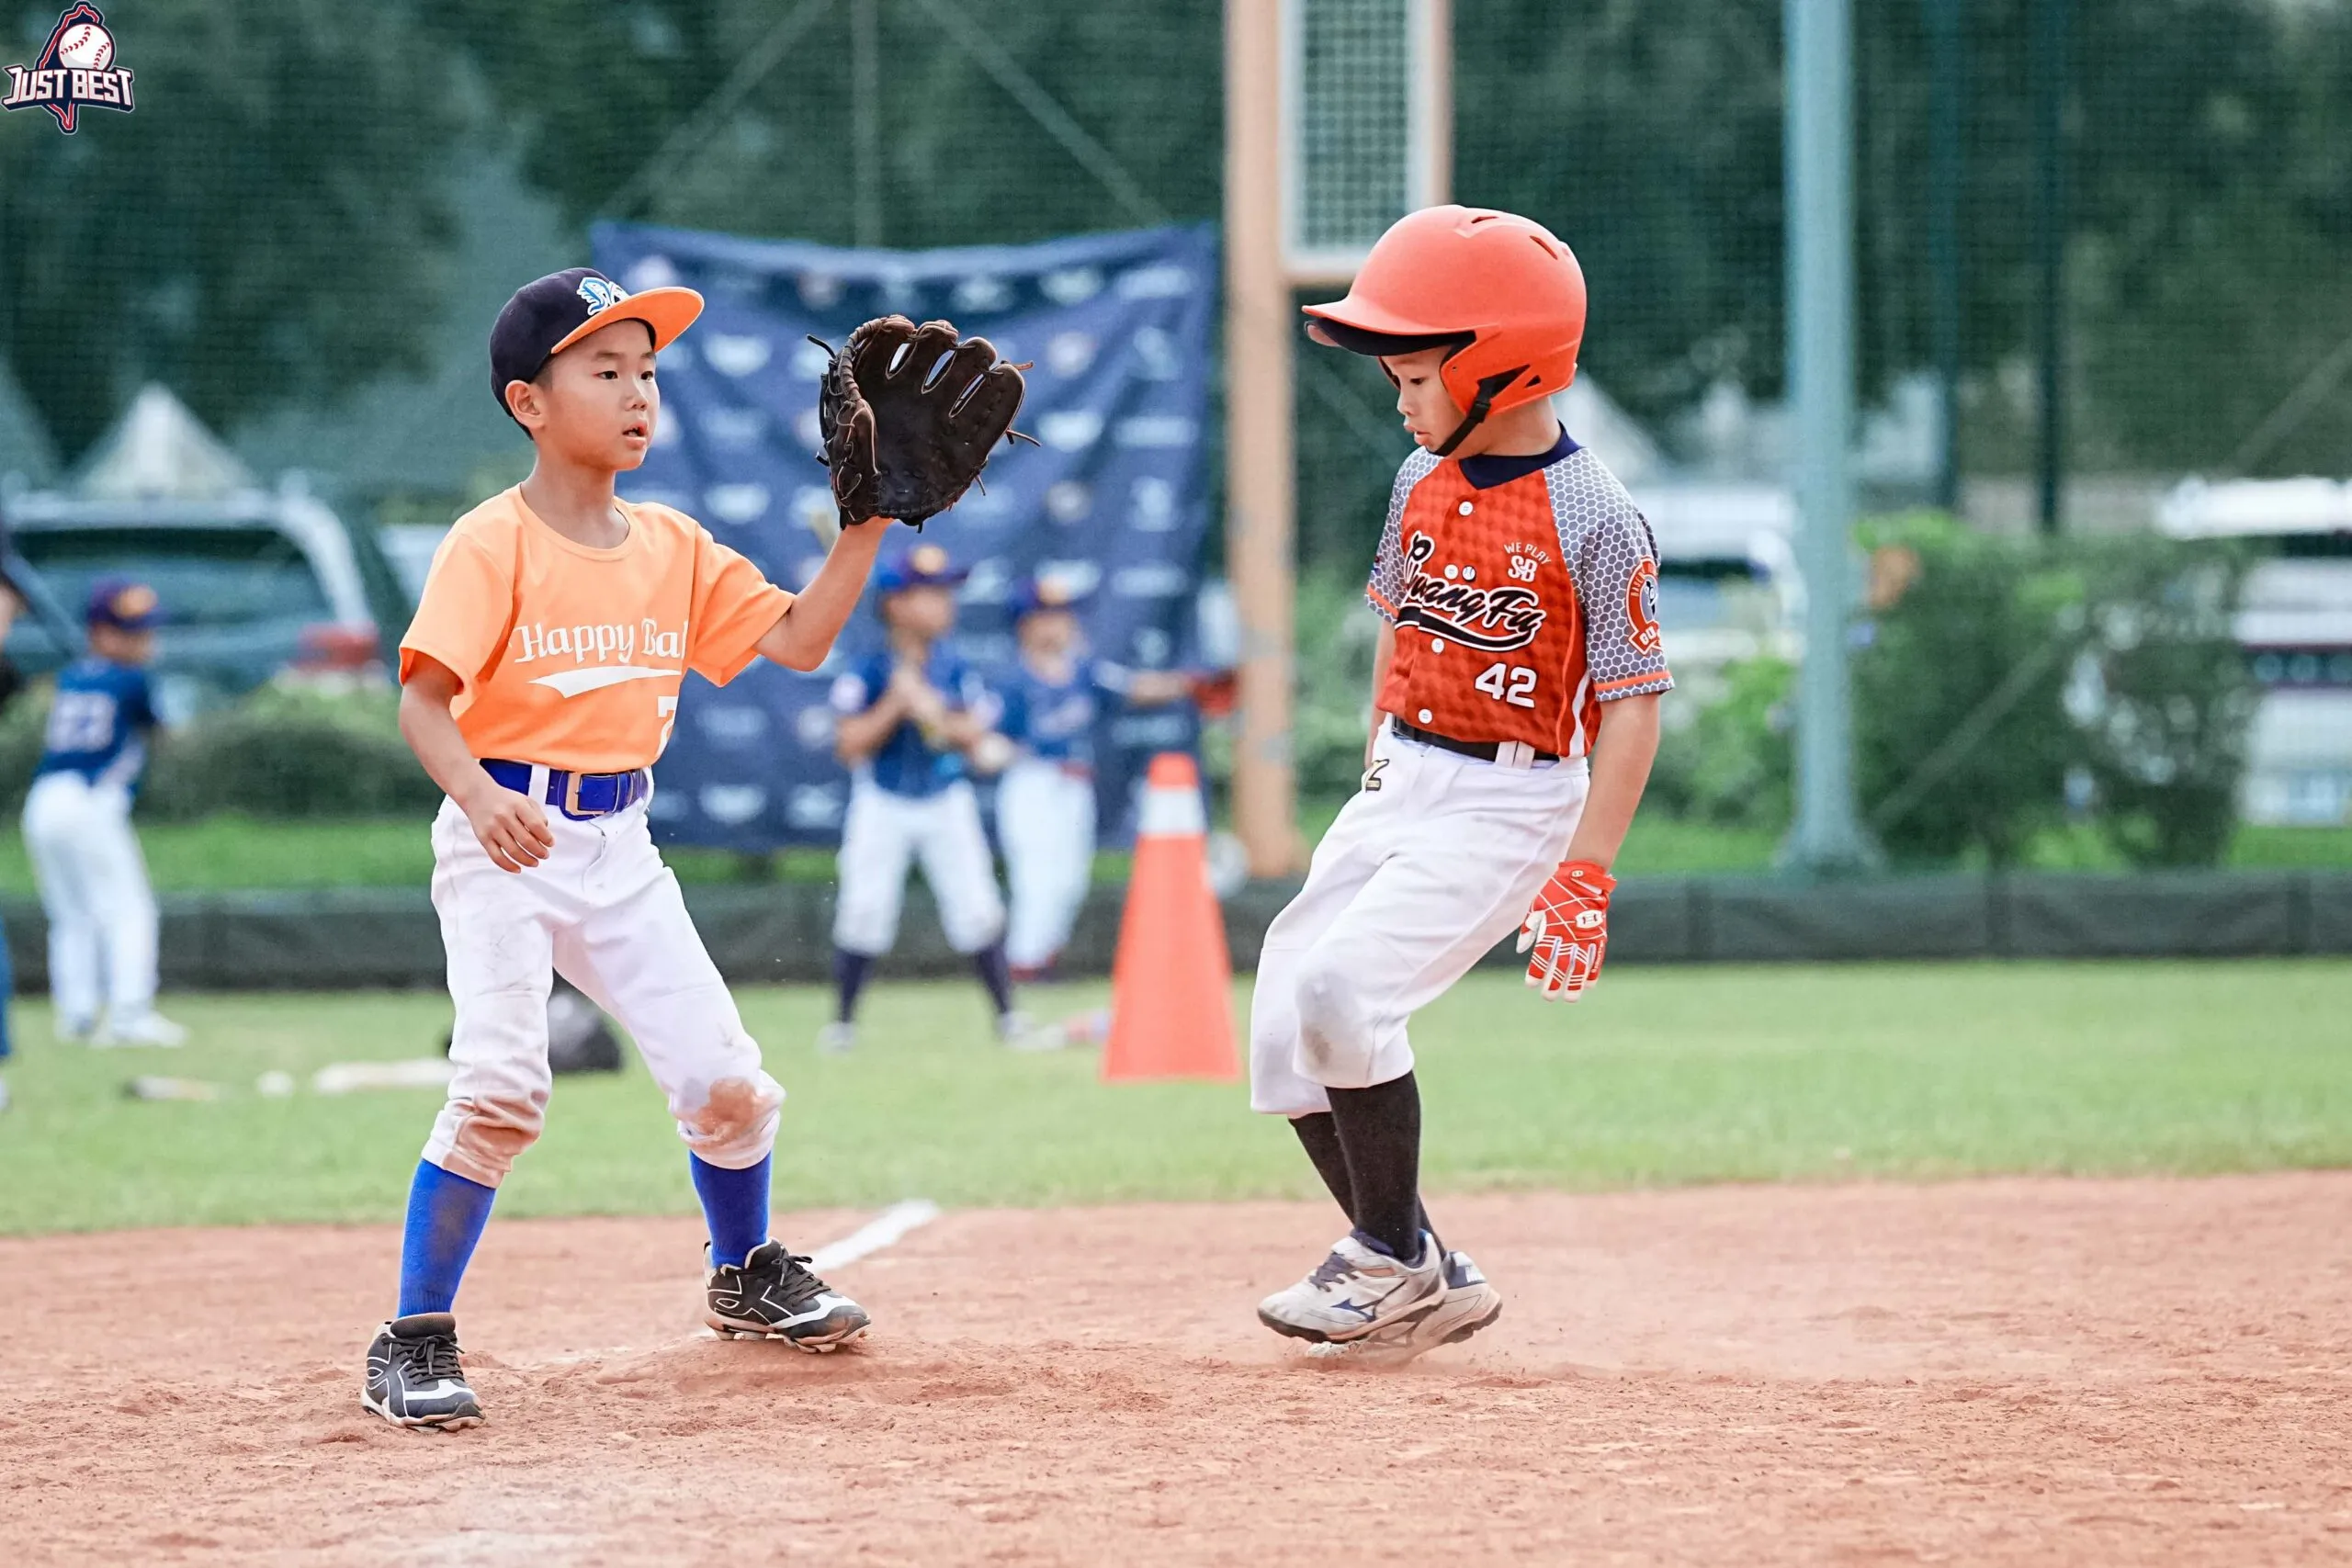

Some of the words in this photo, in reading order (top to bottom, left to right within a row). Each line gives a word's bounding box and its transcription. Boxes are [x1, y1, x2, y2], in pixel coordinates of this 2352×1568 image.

[1504, 542, 1521, 554] WE
[1524, 543, 1552, 565] PLAY
[1508, 555, 1538, 582] SB
[513, 622, 634, 664] Happy
[1474, 661, 1538, 709] 42
